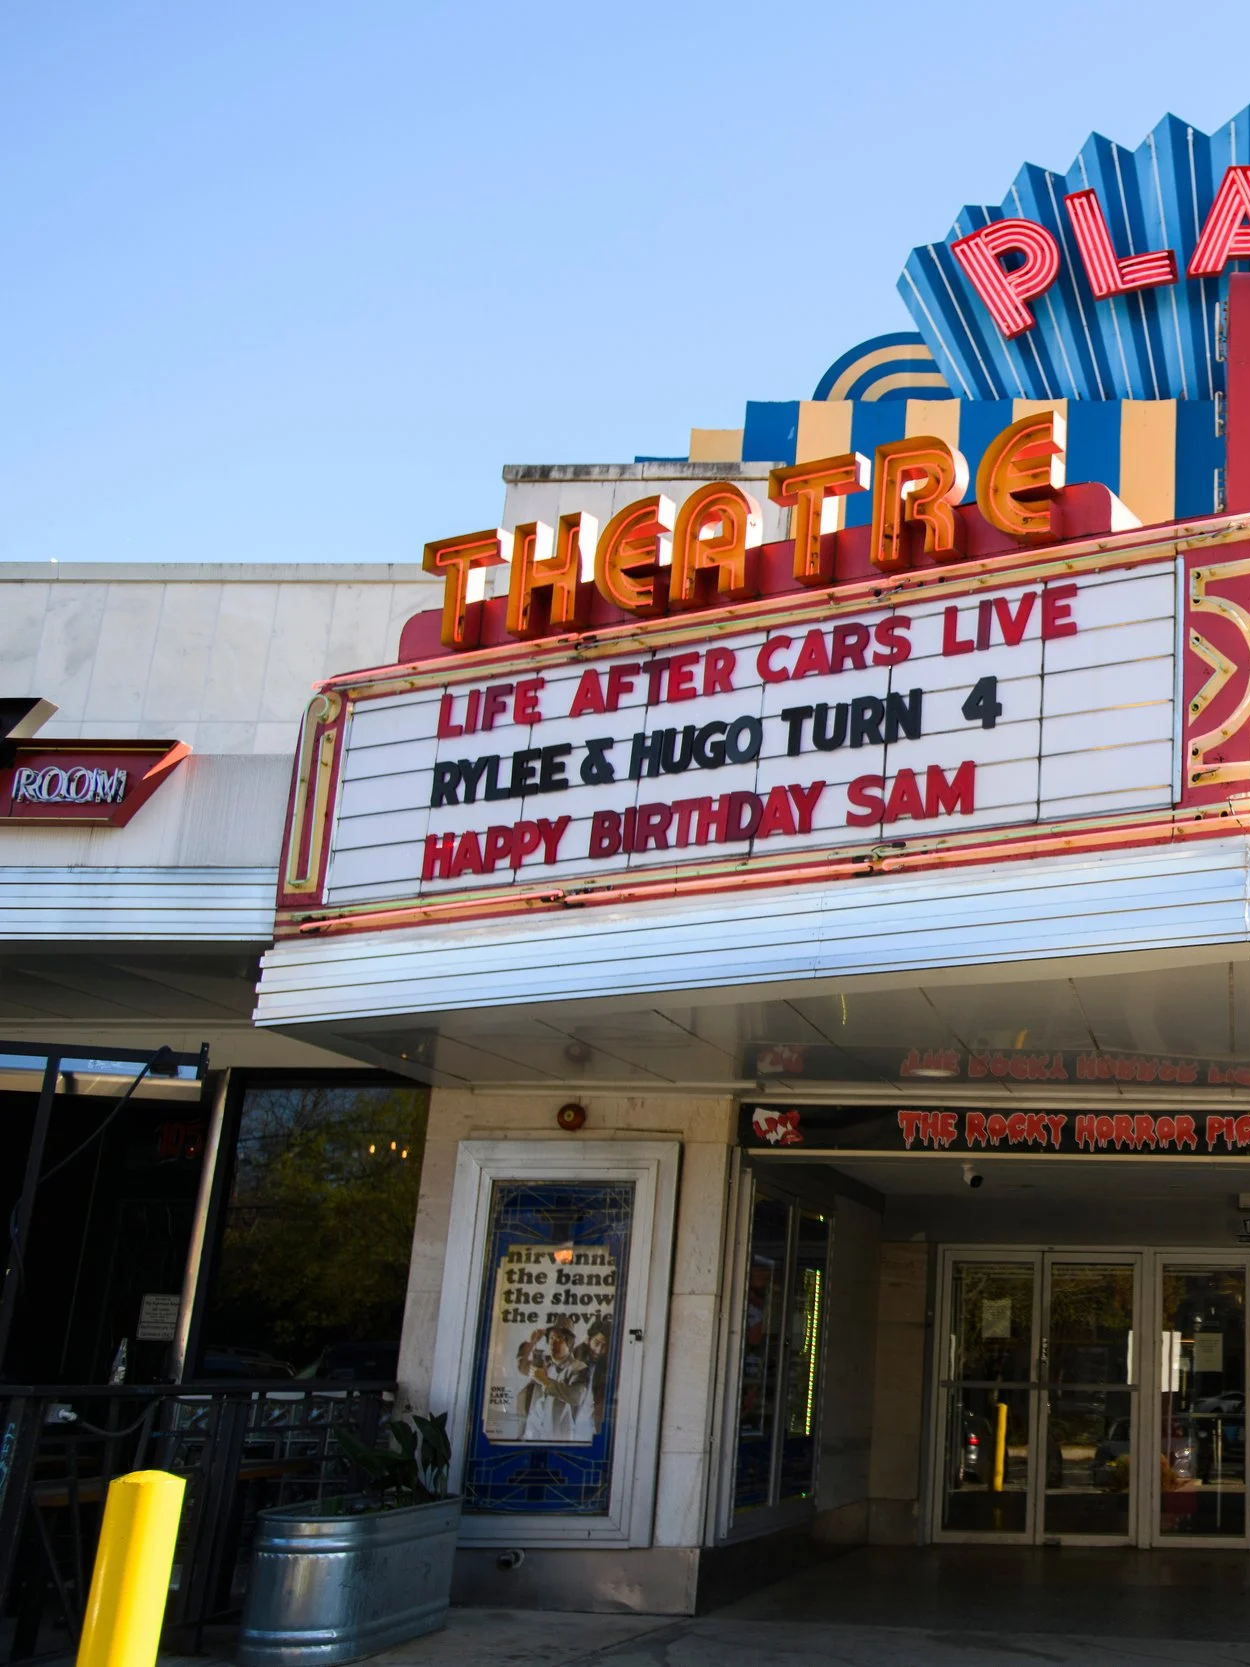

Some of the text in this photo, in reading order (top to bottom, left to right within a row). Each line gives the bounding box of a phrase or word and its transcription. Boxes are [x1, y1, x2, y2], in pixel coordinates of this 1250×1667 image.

[423, 410, 1070, 650] THEATRE
[437, 583, 1078, 739] LIFE AFTER CARS LIVE
[430, 675, 1003, 807] RYLEE & HUGO TURN 4
[12, 766, 127, 803] ROOM
[421, 760, 977, 882] HAPPY BIRTHDAY SAM
[898, 1110, 958, 1151] THE
[964, 1111, 1068, 1151] ROCKY
[1075, 1113, 1199, 1153] HORROR
[503, 1288, 615, 1306] the show
[505, 1268, 616, 1287] the band
[501, 1307, 614, 1325] the movie
